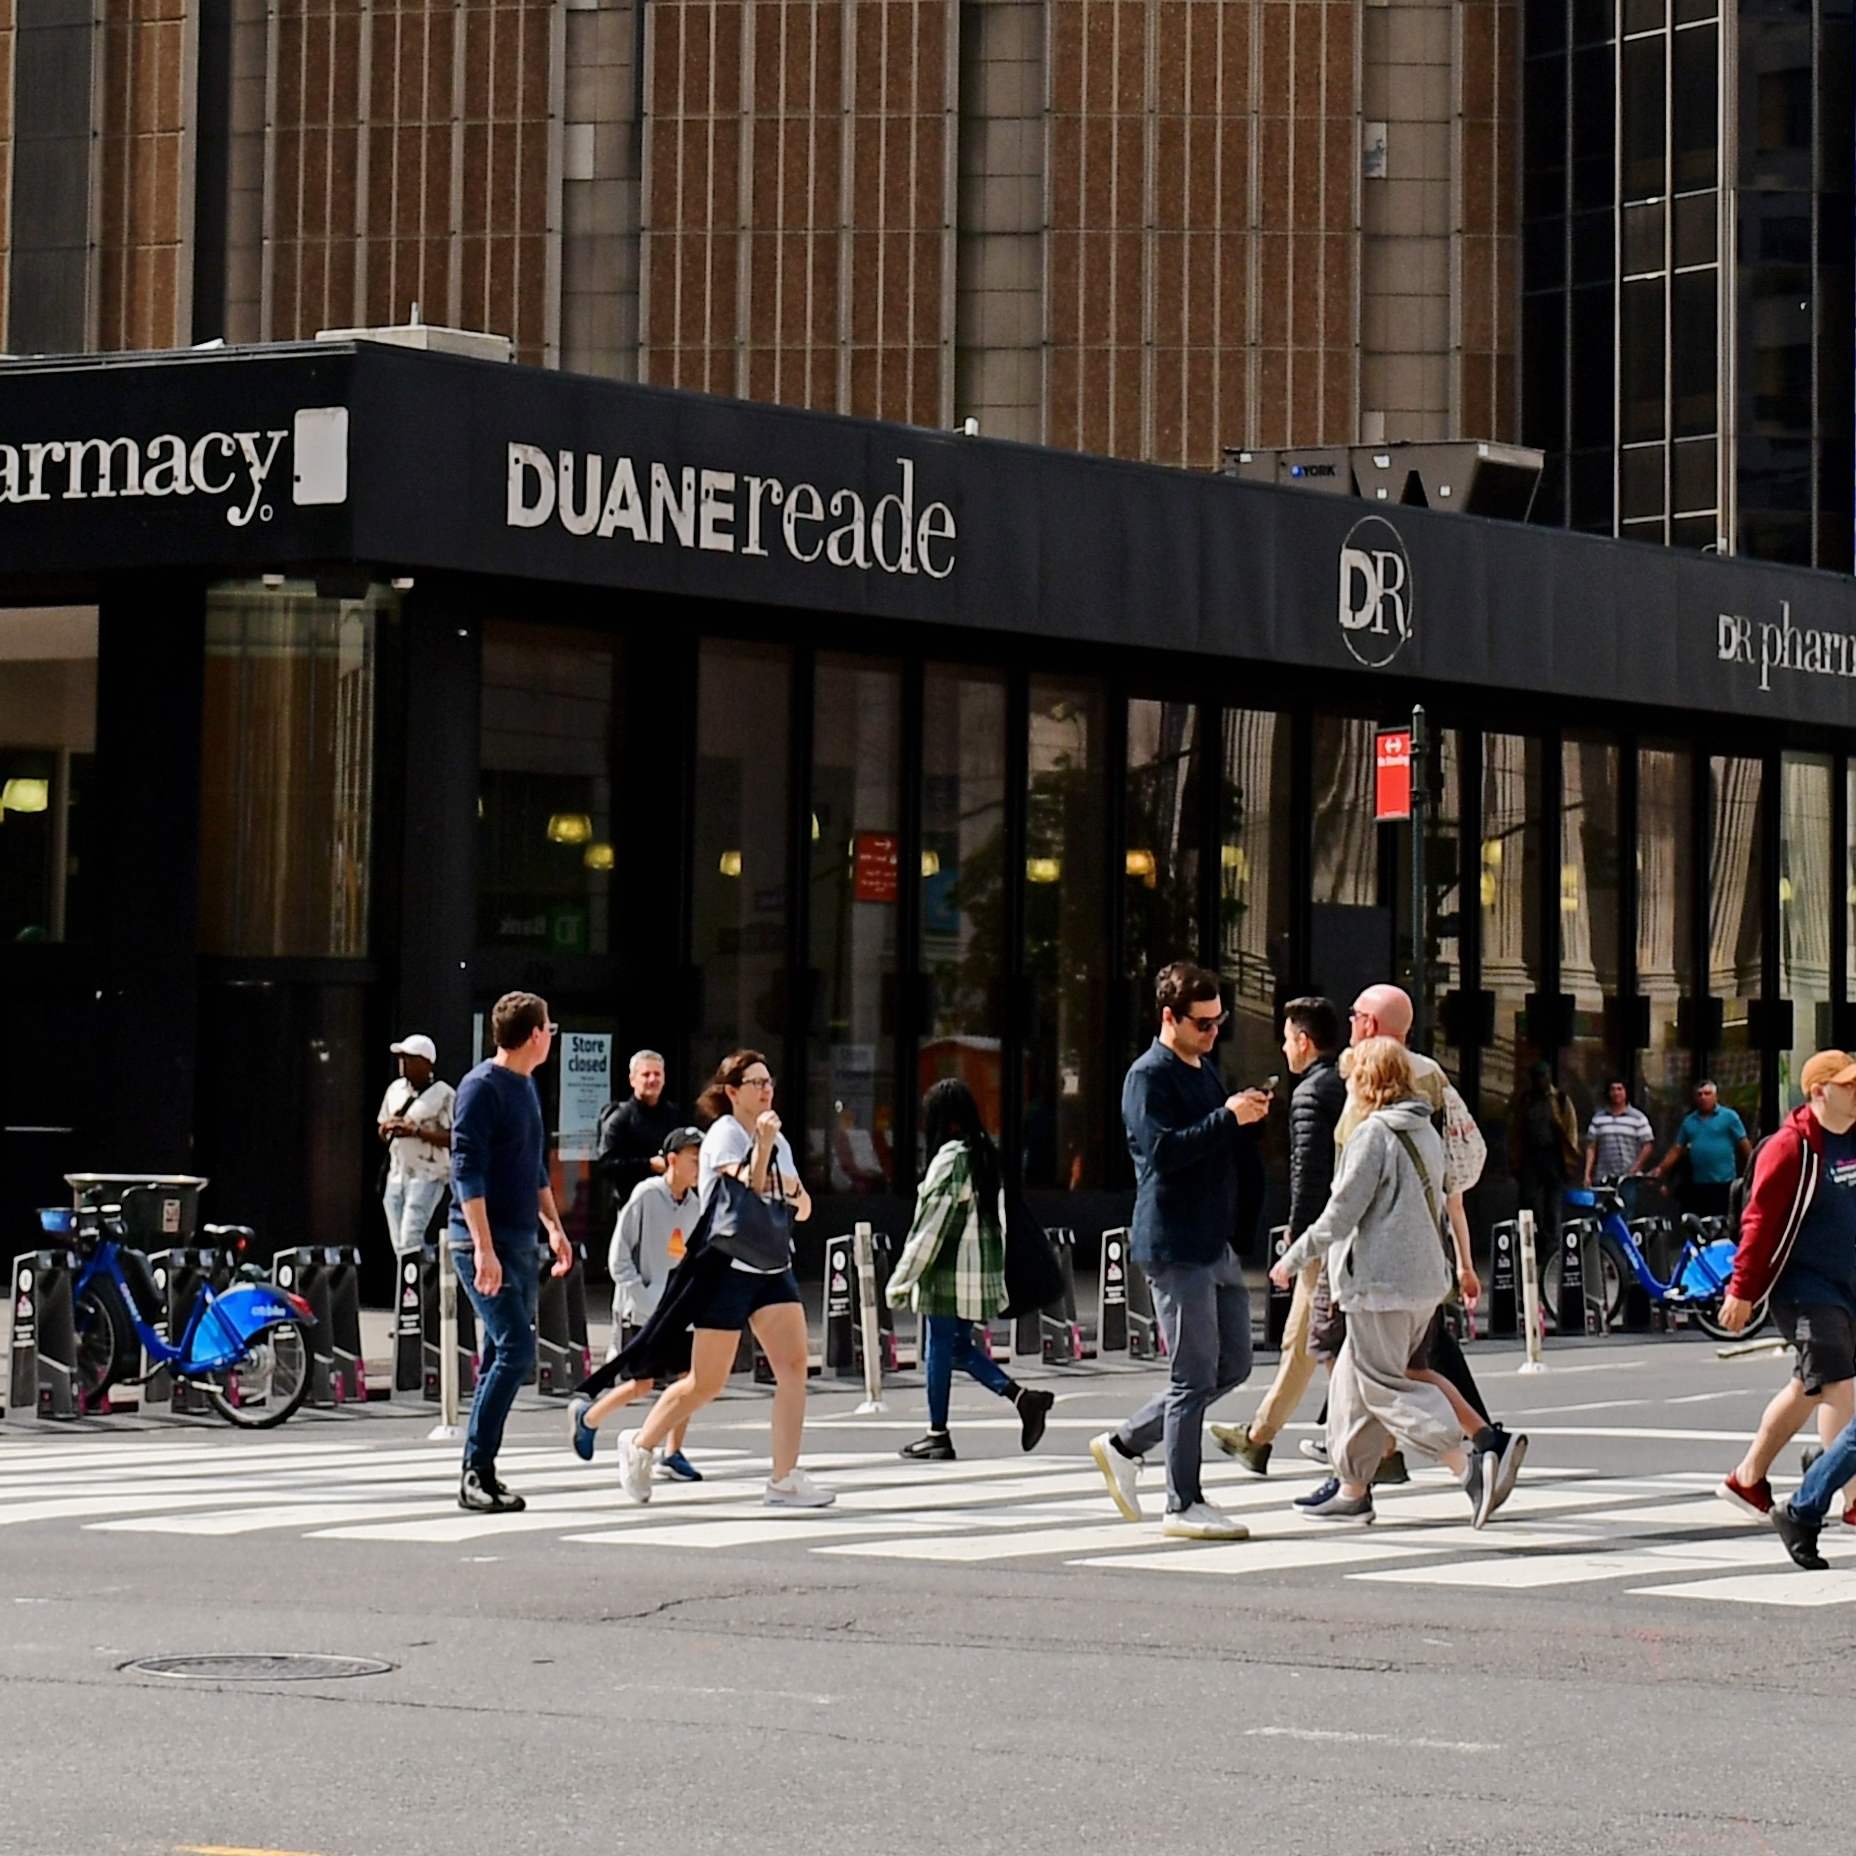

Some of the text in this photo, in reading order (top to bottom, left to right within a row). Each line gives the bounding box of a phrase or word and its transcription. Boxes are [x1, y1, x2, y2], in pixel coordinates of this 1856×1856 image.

[1303, 465, 1336, 477] YORK
[1338, 548, 1413, 642] DR
[1717, 612, 1756, 665] DR
[571, 1036, 605, 1054] Store
[568, 1054, 608, 1073] closed
